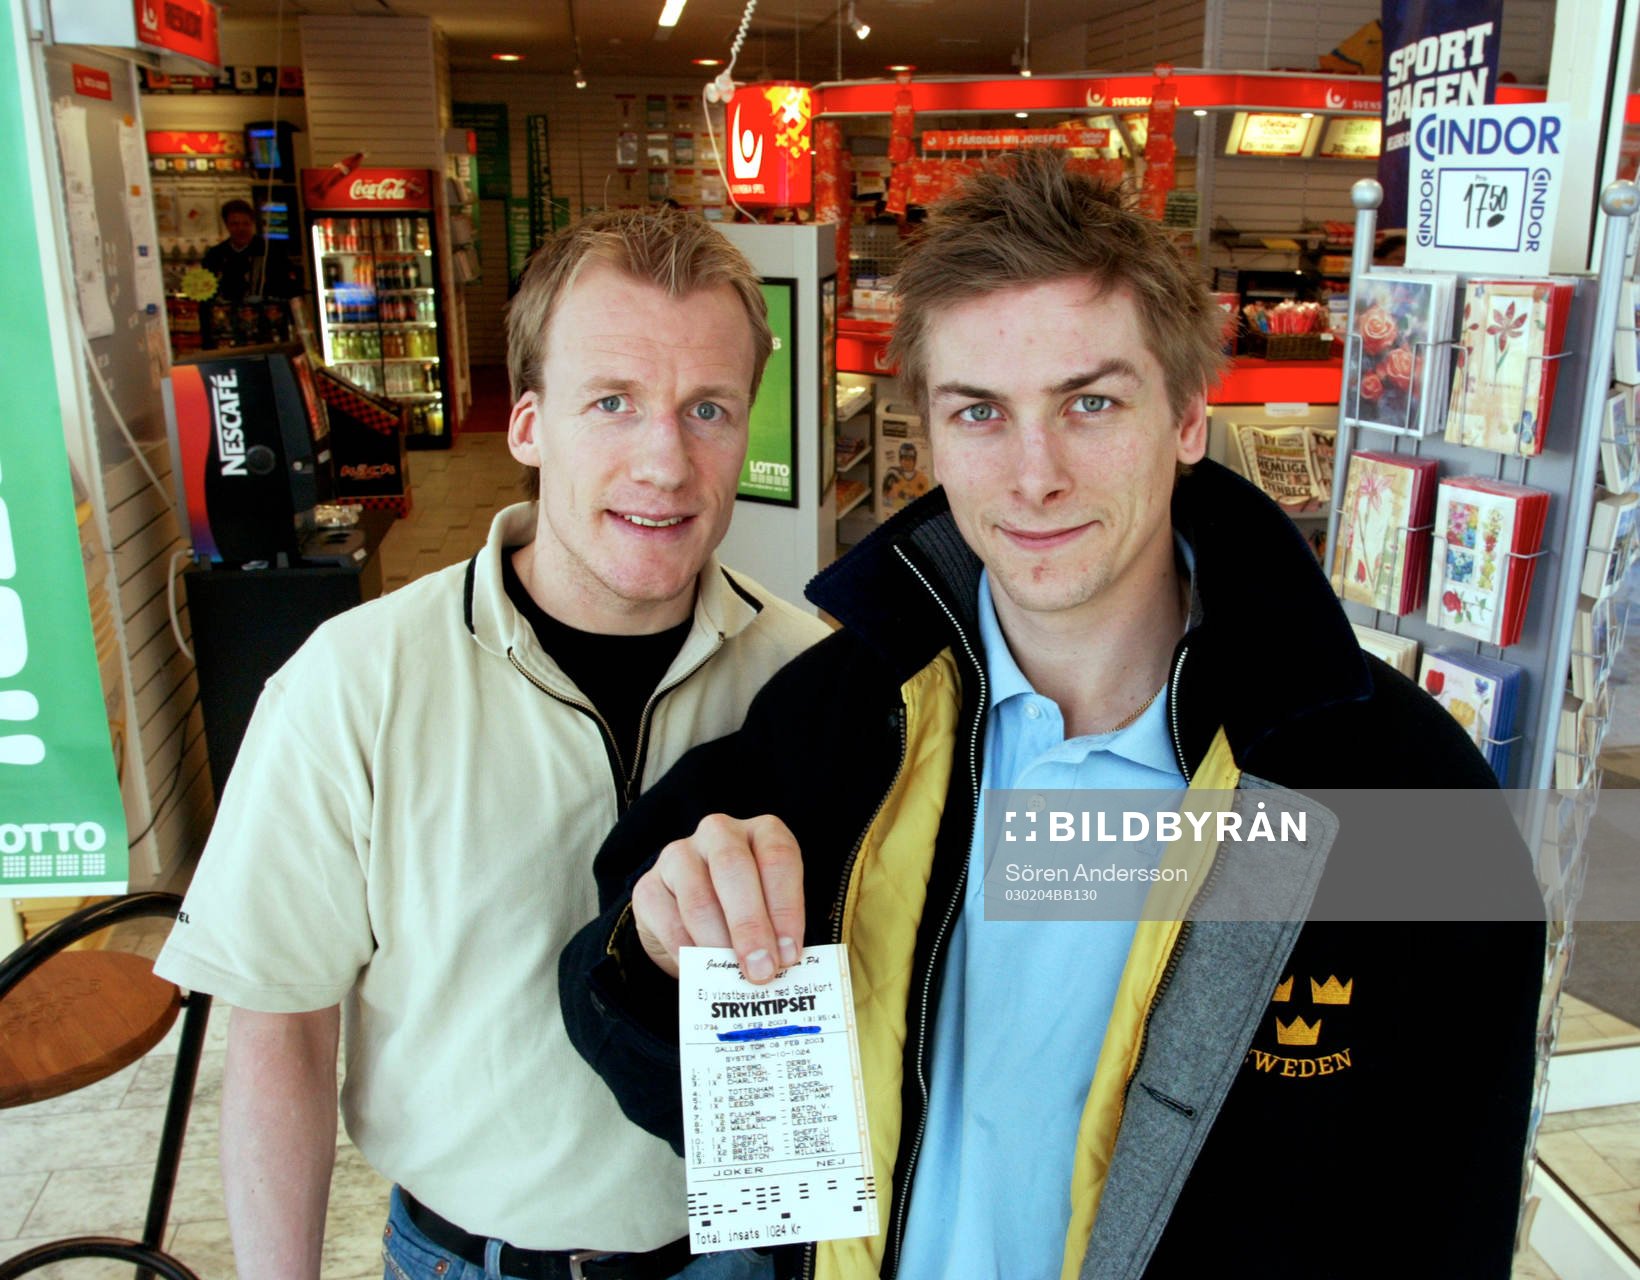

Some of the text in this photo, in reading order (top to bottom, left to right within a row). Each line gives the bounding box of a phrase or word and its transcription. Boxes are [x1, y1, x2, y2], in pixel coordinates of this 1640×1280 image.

[1388, 22, 1493, 87] SPORT
[1352, 100, 1382, 110] SVENS
[1386, 67, 1488, 126] BAGEN
[1415, 113, 1561, 162] CINDOR
[1416, 168, 1435, 247] CINDOR
[1526, 168, 1552, 252] CINDOR
[750, 460, 790, 477] LOTTO
[0, 821, 106, 854] OTTO
[698, 983, 833, 1001] Ej vinstbevakat med Spelkort
[711, 995, 816, 1018] STRYKTIPSET
[725, 1054, 755, 1062] SYSTEM
[1244, 1047, 1352, 1078] WEDEN
[727, 1085, 773, 1095] TOTTENHAM
[713, 1158, 845, 1177] JOKER NEJ
[695, 1231, 721, 1245] Total
[728, 1230, 760, 1243] insats
